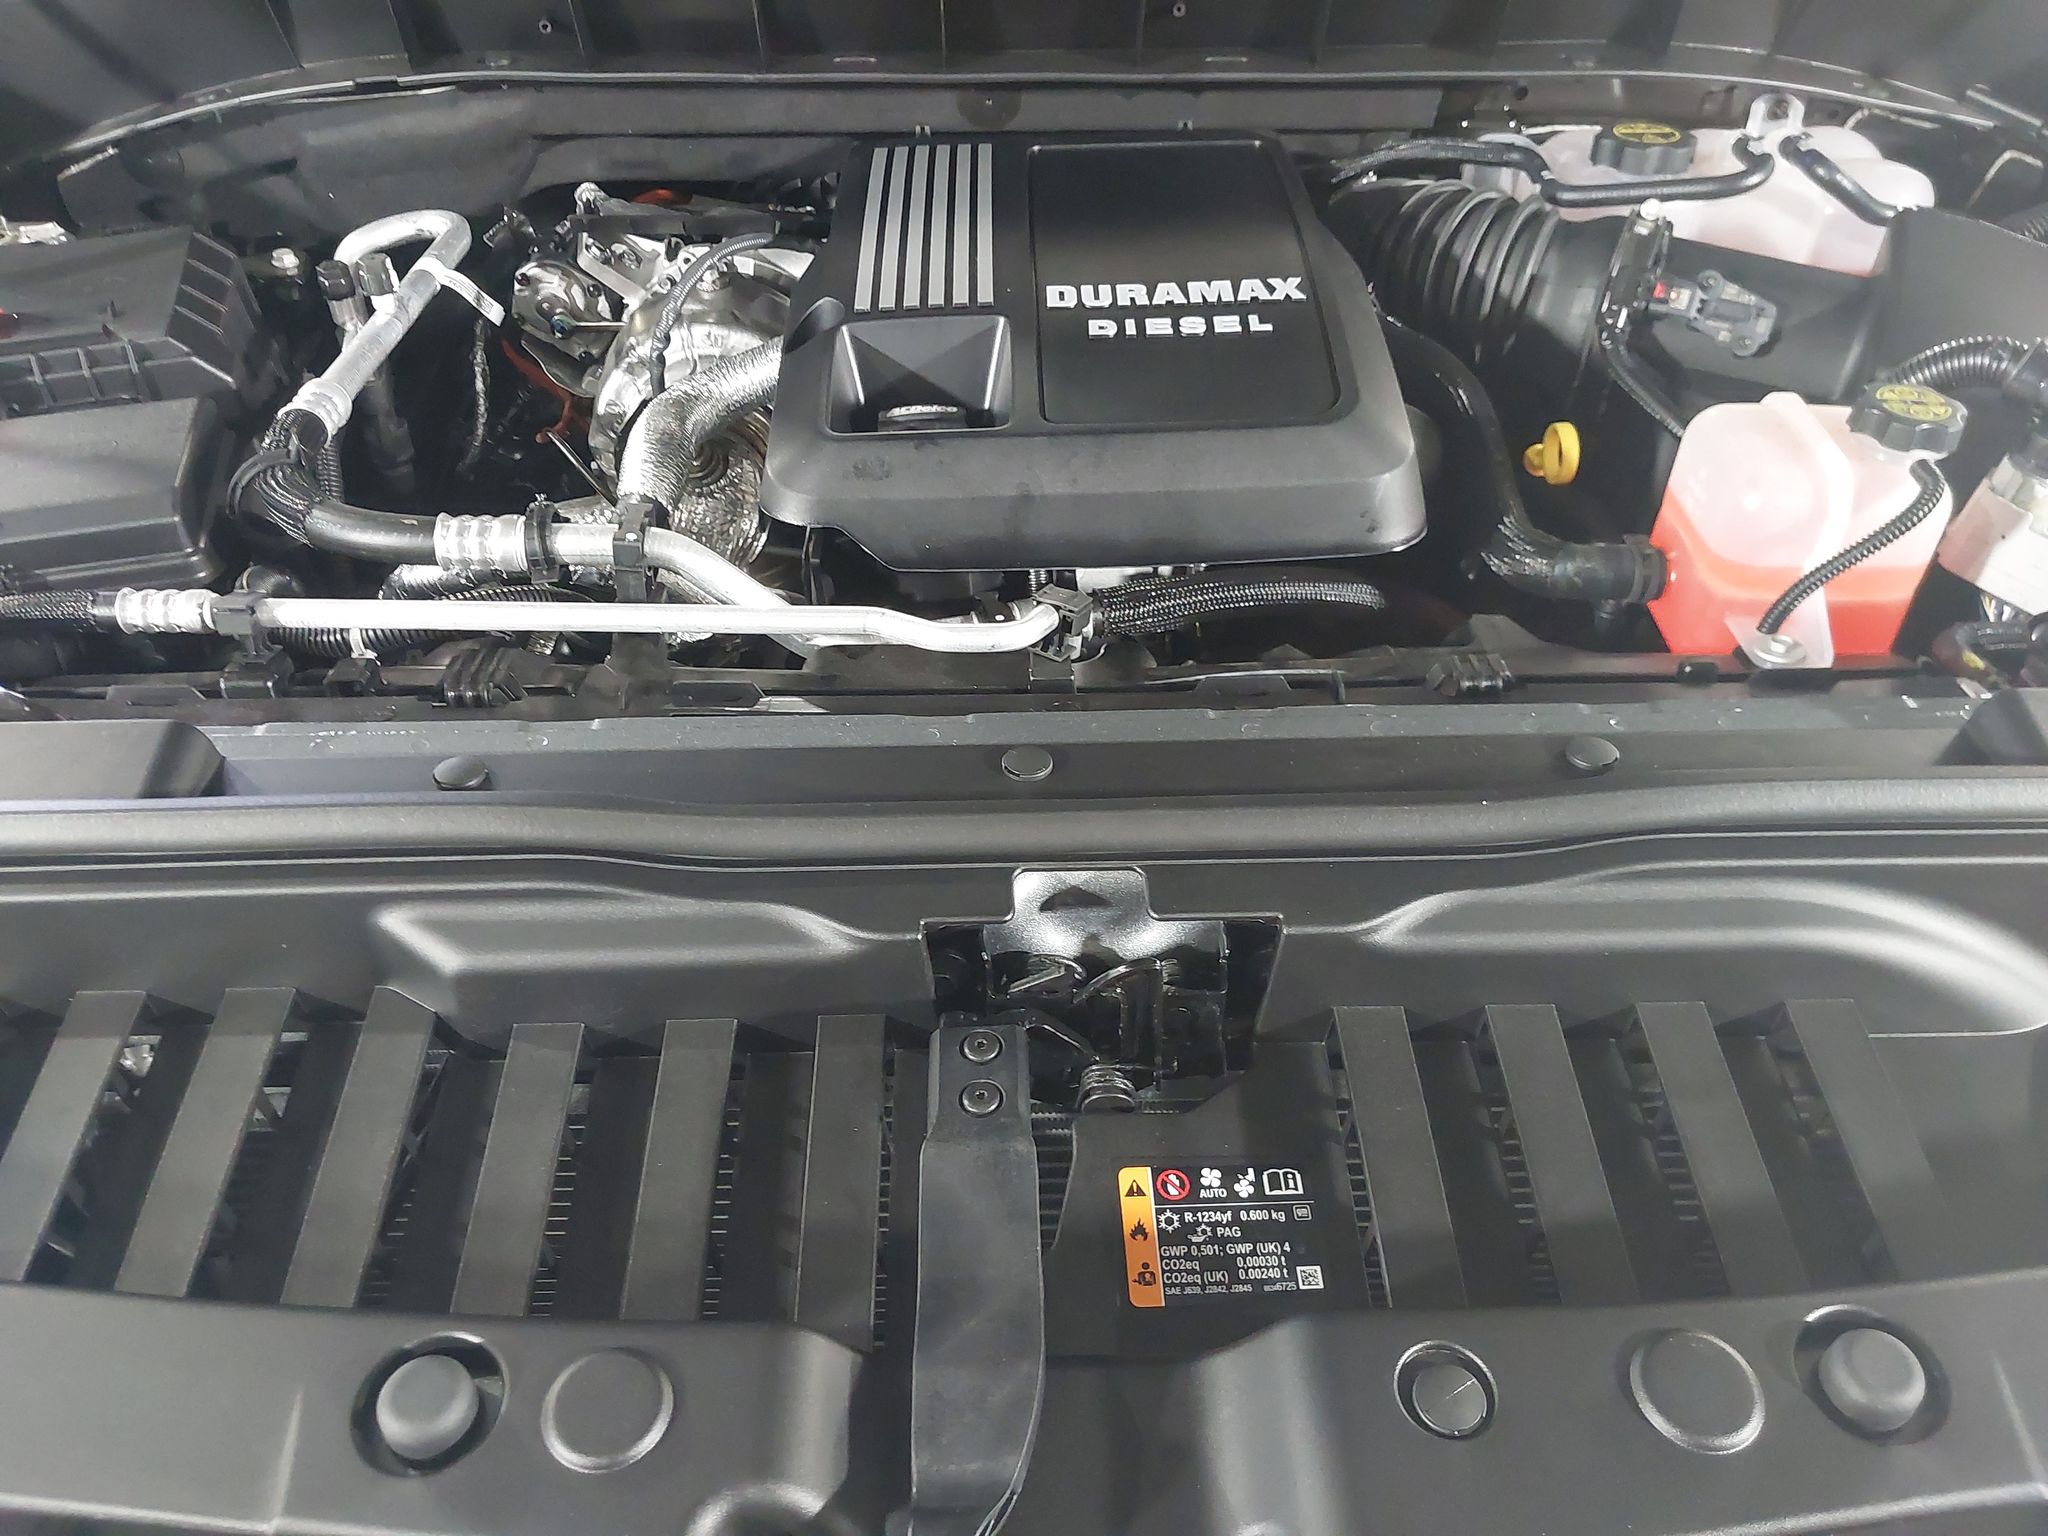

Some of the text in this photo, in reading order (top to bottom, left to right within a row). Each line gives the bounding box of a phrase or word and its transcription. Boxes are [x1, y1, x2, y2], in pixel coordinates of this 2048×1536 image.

[1046, 277, 1306, 308] DURAMAX
[1088, 315, 1273, 338] DIESEL
[1199, 1188, 1227, 1198] AUTO
[1184, 1209, 1285, 1224] R-1234yf 0.600 kg
[1216, 1226, 1241, 1237] PAG
[1160, 1241, 1291, 1257] GWP 0,501; GWP (UK) 4
[1162, 1255, 1286, 1271] CO2eq 0,00030 t
[1164, 1267, 1288, 1285] CO2eq (UK) 0.00240 t
[1164, 1286, 1181, 1295] SAE
